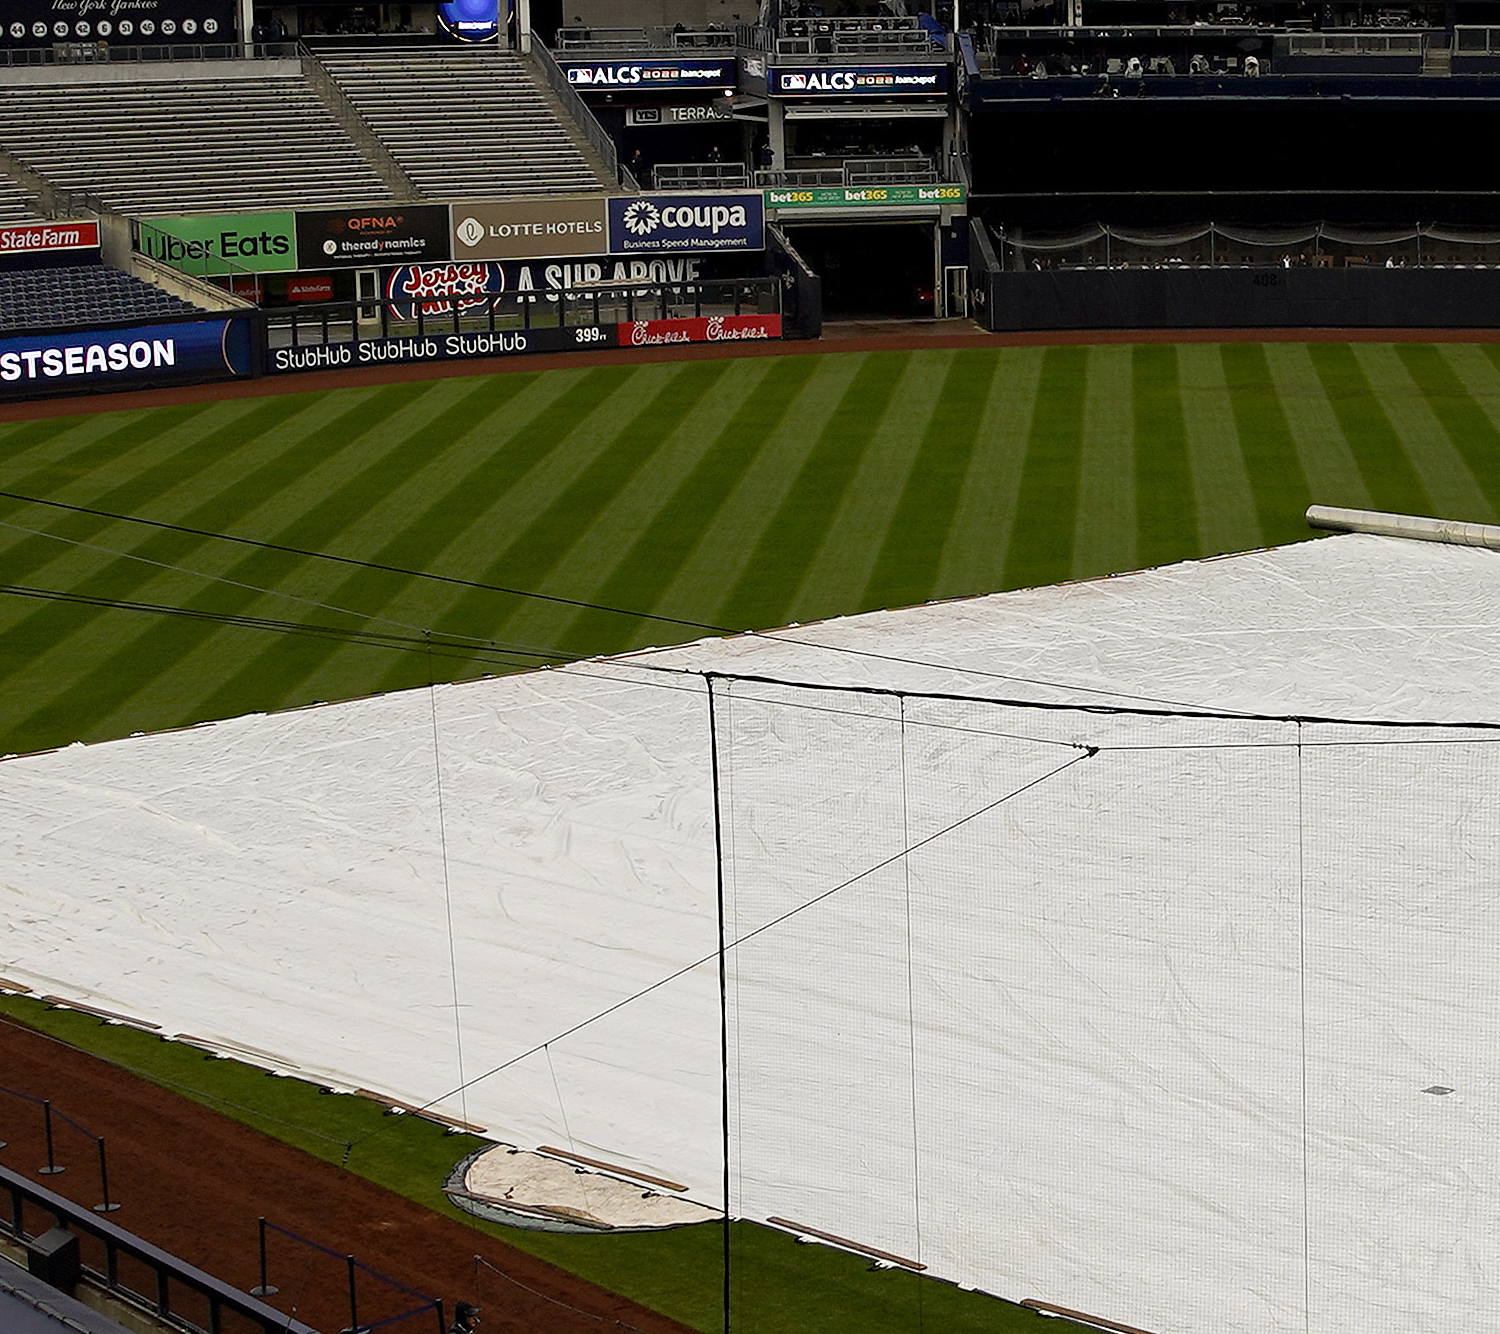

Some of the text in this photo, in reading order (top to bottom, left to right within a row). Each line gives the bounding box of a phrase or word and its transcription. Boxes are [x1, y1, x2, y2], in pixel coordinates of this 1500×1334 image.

[592, 66, 642, 84] ALCS
[806, 72, 856, 90] ALCS
[770, 192, 813, 203] bet365
[845, 190, 888, 201] bet365
[918, 188, 961, 199] bet365
[347, 216, 397, 230] QFNA
[489, 220, 602, 238] LOTTE HOTELS
[661, 205, 747, 235] coupa
[148, 232, 290, 262] Uber Eats
[341, 237, 426, 252] theradynamics
[623, 236, 748, 249] Business Spend Management
[403, 261, 491, 293] Jersey
[517, 264, 537, 303] A
[575, 326, 600, 343] 399
[275, 333, 527, 368] StubHub StubHub StubHub
